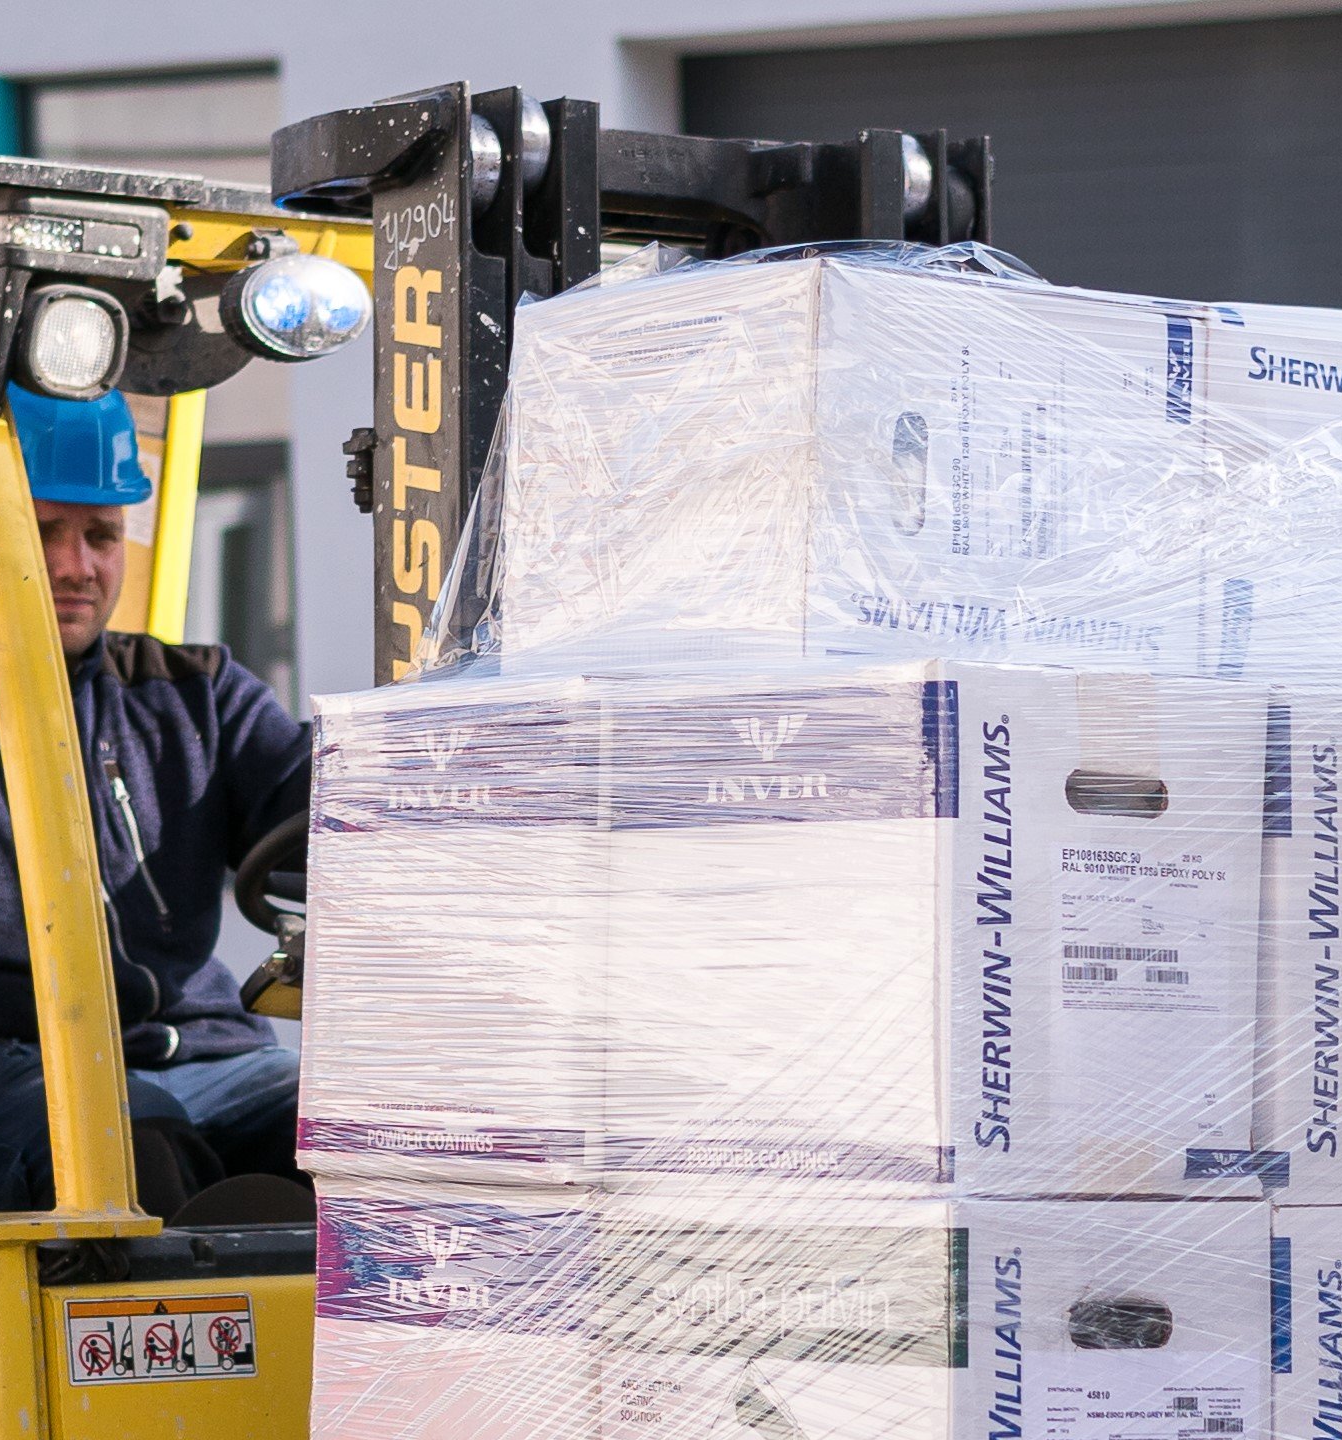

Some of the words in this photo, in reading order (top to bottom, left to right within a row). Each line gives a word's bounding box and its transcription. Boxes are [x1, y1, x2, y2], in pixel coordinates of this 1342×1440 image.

[393, 264, 443, 681] YSTER
[706, 772, 829, 804] INVER
[1062, 862, 1081, 872] RAL
[1084, 864, 1105, 873] 9010
[1108, 864, 1137, 876] WHITE
[1160, 868, 1189, 879] EPOXY
[1191, 870, 1214, 881] POLY
[387, 1278, 492, 1309] INVER
